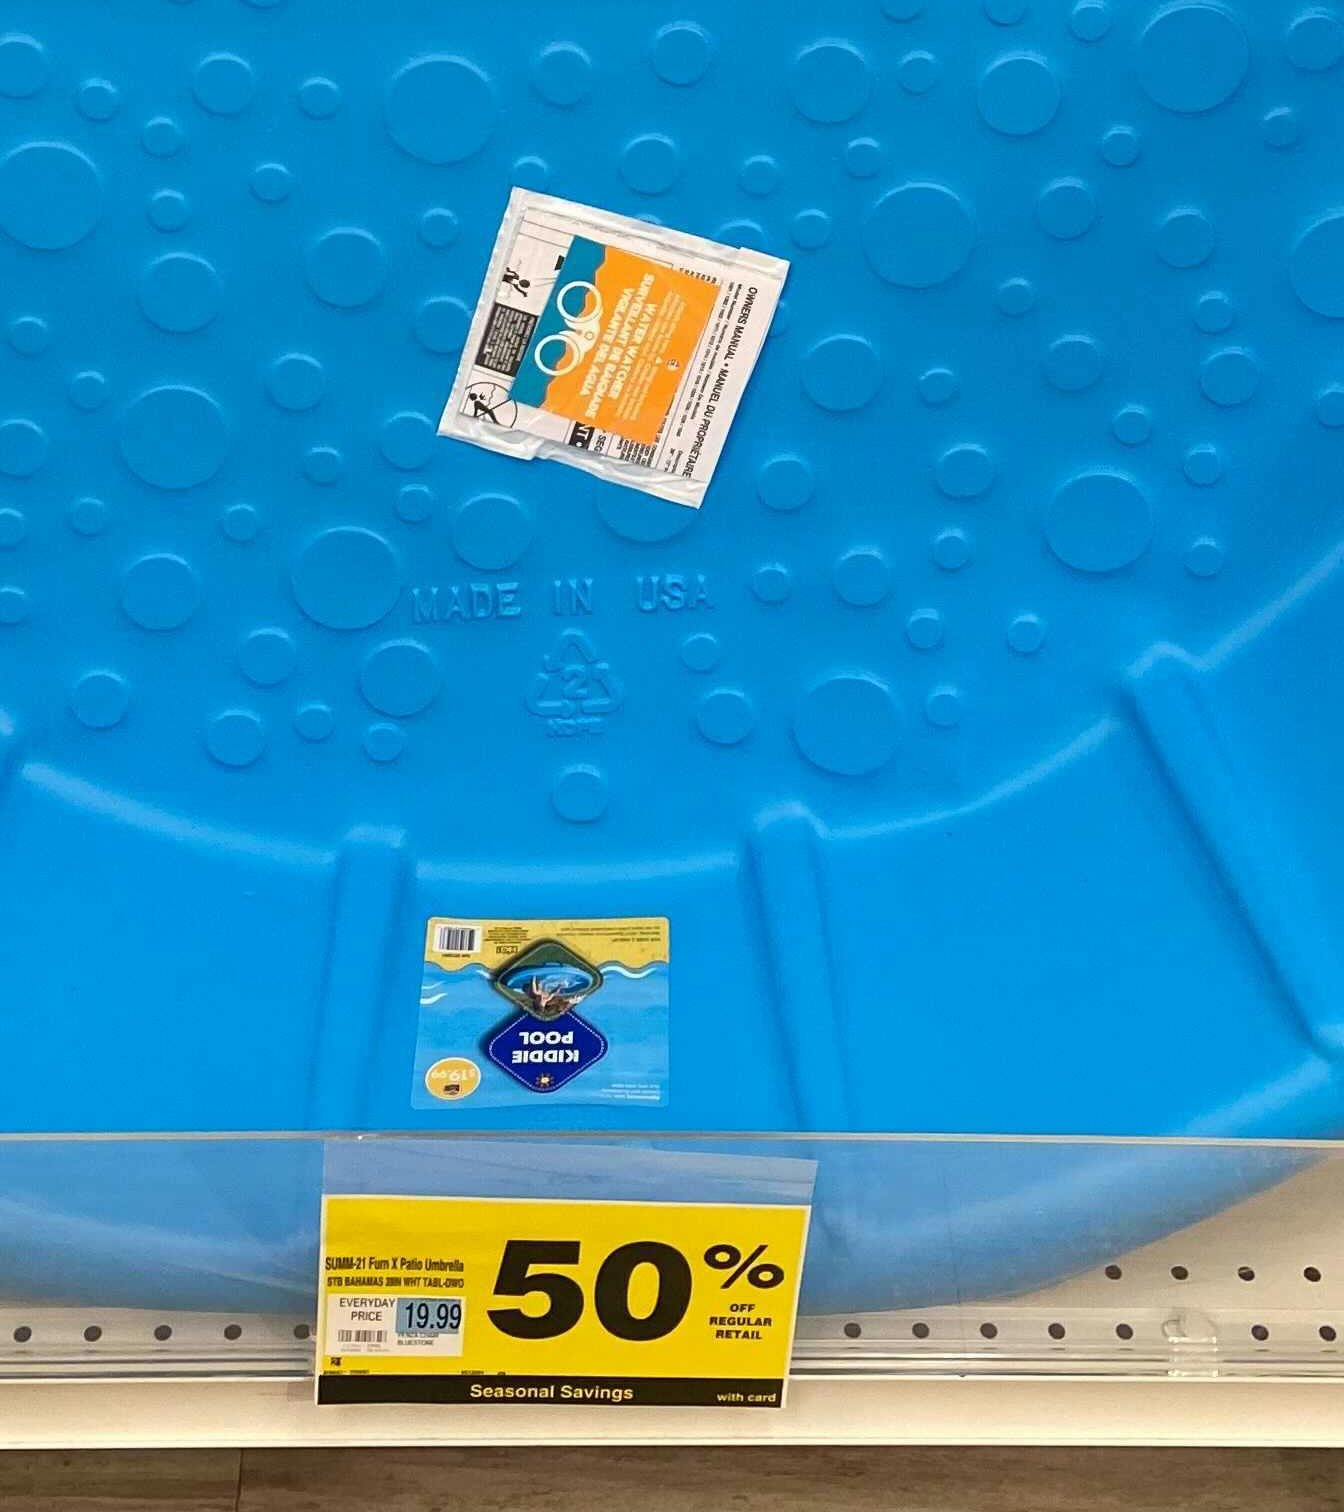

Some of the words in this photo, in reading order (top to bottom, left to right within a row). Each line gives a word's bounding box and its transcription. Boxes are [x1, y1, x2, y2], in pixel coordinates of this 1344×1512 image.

[738, 287, 758, 325] OWNERS
[633, 303, 656, 345] WATER
[729, 325, 745, 361] MANUAL
[709, 368, 729, 407] MANUEL
[706, 406, 716, 419] DU
[410, 582, 522, 624] MADE
[554, 577, 595, 617] IN
[635, 574, 714, 613] USA
[519, 1031, 574, 1046] POOL
[511, 1049, 580, 1064] KIDDIE
[369, 1257, 390, 1270] Furn
[391, 1257, 400, 1270] X
[400, 1257, 424, 1271] Patio
[425, 1258, 465, 1272] Umbrella
[345, 1277, 384, 1287] BAHAMAS
[339, 1297, 396, 1308] EVERYDAY
[405, 1302, 462, 1329] 19.99
[729, 1303, 755, 1313] OFF
[351, 1311, 383, 1321] PRICE
[709, 1316, 773, 1327] REGULAR
[715, 1329, 763, 1340] RETAIL
[469, 1383, 555, 1399] Seasonal
[560, 1384, 634, 1402] Savings
[716, 1392, 744, 1402] with
[747, 1393, 777, 1403] card
